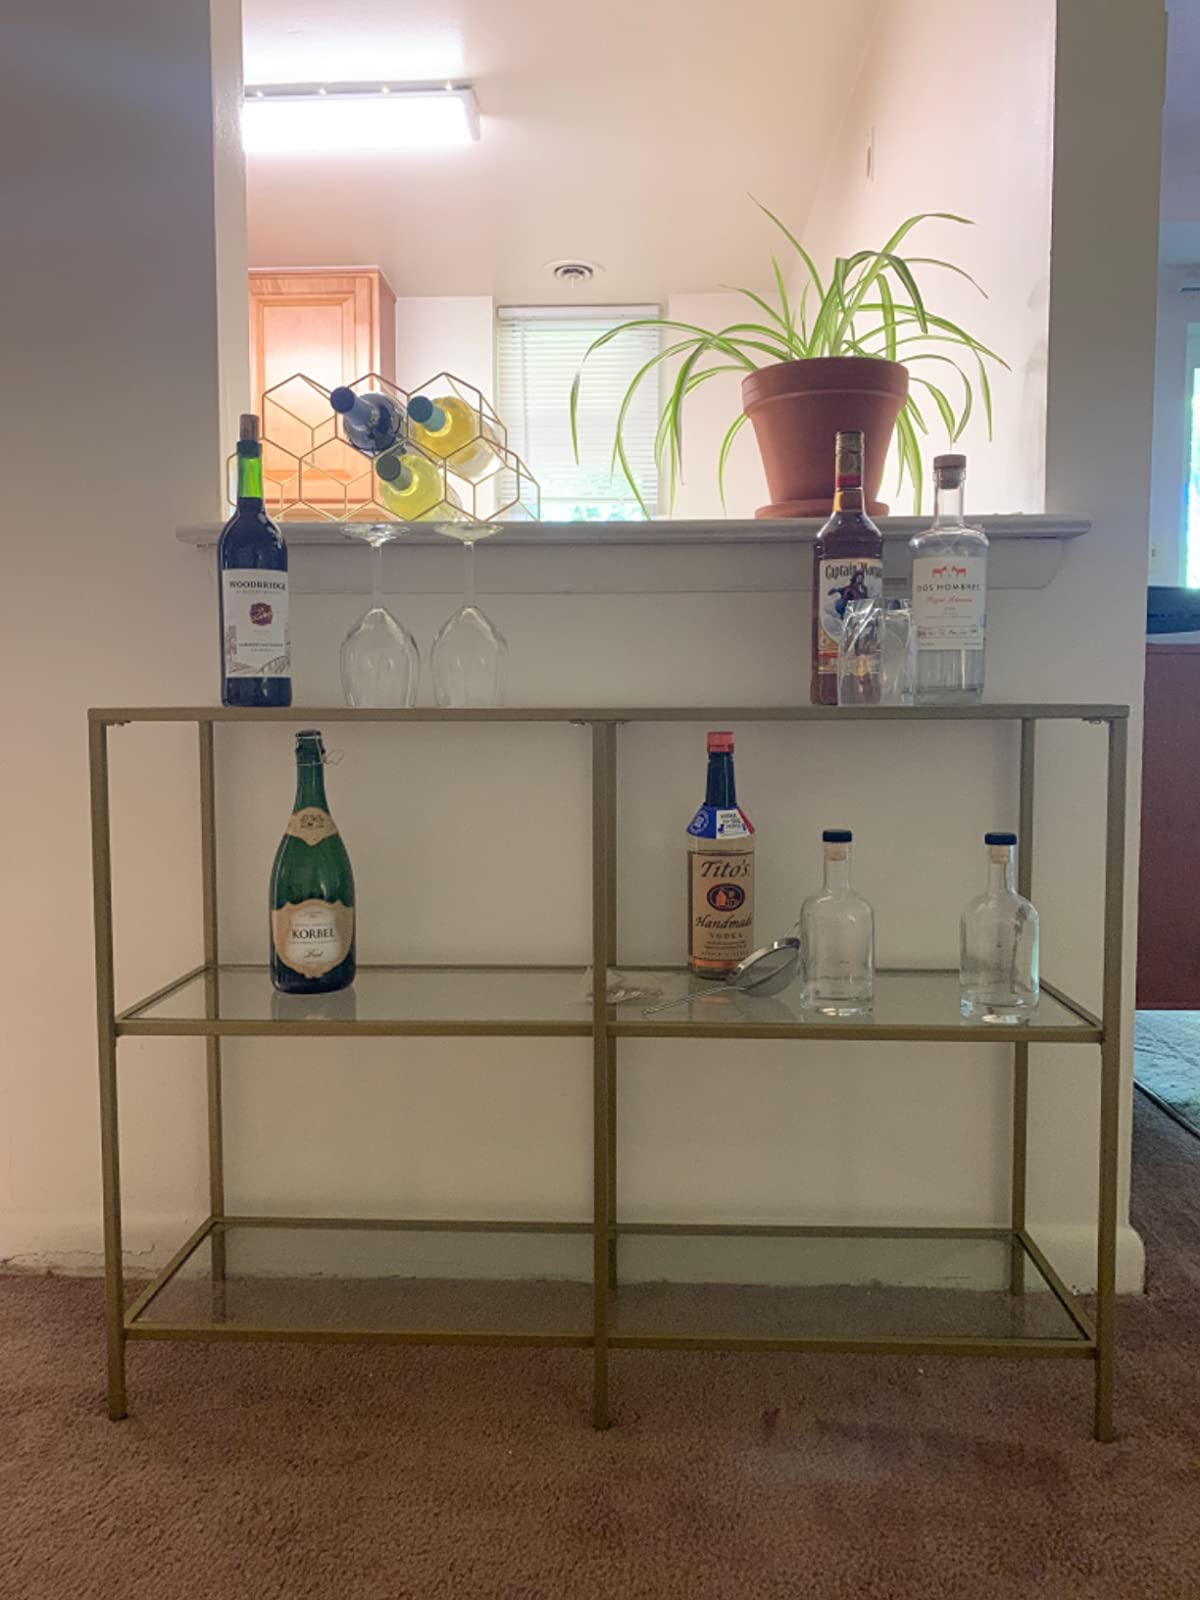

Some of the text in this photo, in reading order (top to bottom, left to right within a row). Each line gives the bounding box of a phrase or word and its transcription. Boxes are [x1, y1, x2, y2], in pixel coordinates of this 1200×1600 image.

[825, 563, 858, 580] Captain
[230, 581, 286, 590] WOODBRIDGE
[916, 583, 981, 593] DOS HOMBRES
[701, 859, 750, 879] Tito's
[292, 927, 336, 940] KORBEL
[710, 932, 743, 940] VODKA
